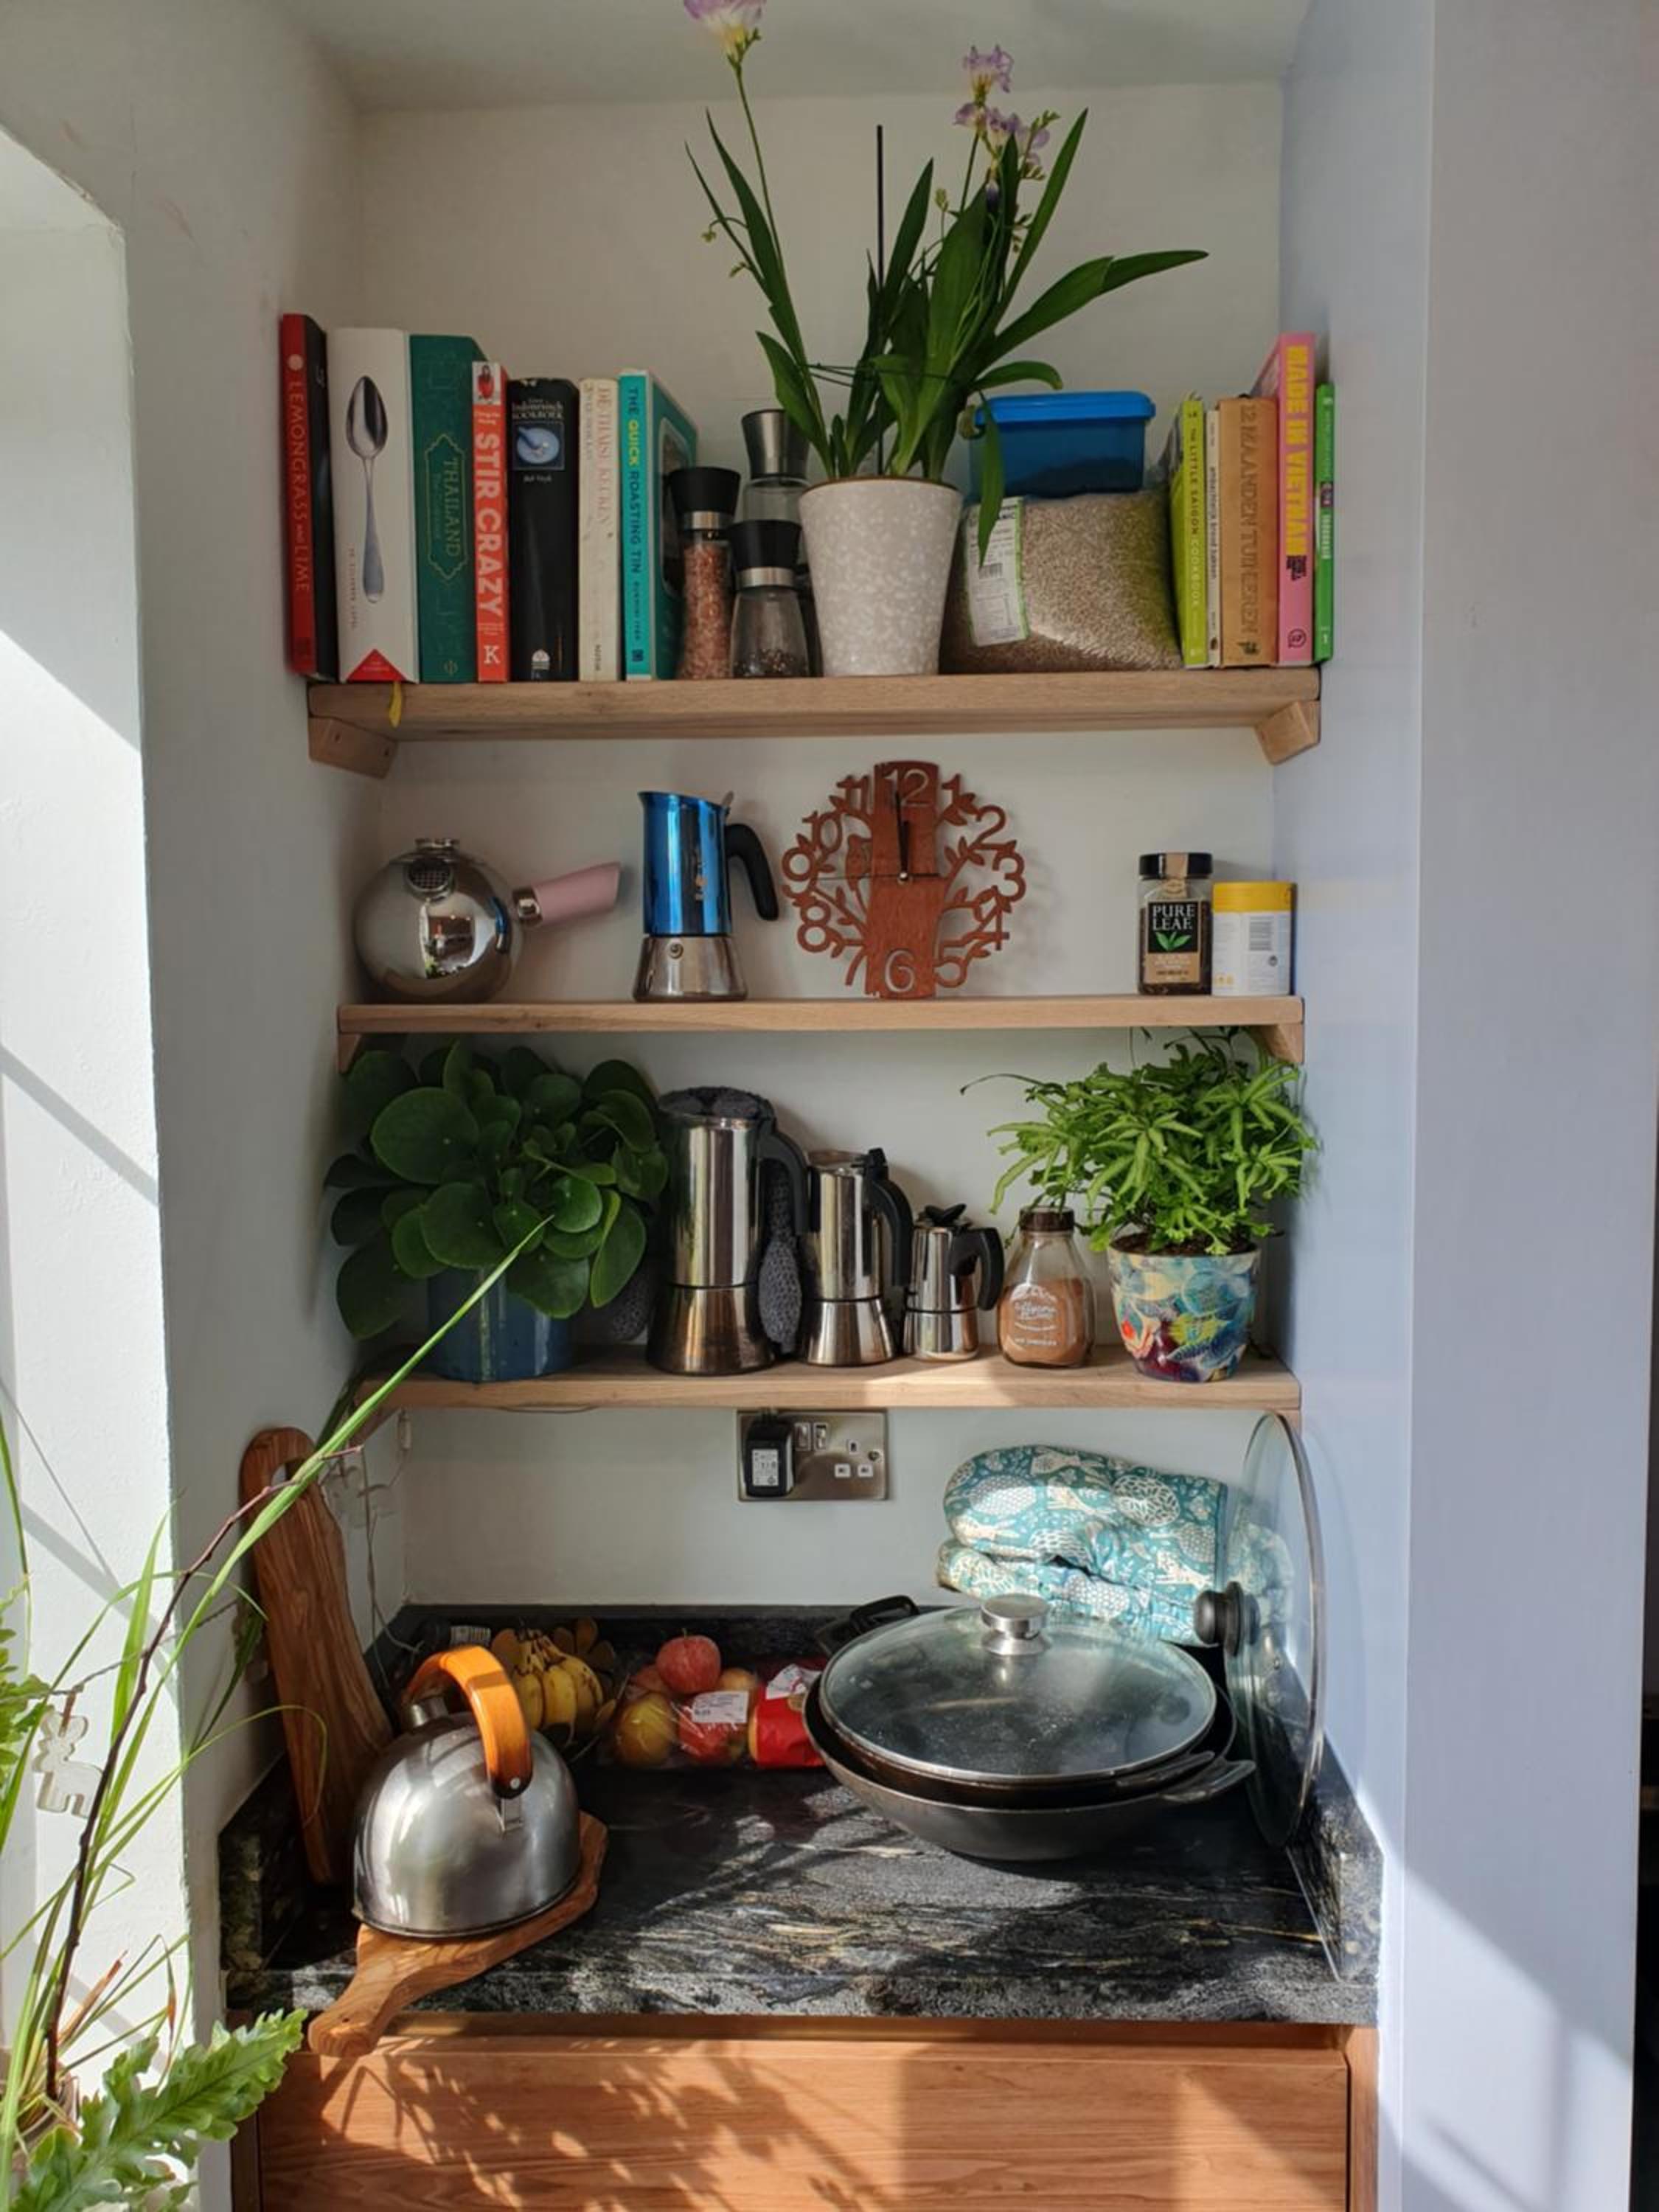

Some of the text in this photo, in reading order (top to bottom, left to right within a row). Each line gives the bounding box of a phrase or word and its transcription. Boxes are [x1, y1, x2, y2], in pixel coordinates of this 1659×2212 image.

[1285, 344, 1309, 414] MADE
[1240, 405, 1255, 423] 12
[1286, 418, 1309, 445] IN
[289, 380, 307, 521] LEMONGRASS
[476, 431, 501, 500] STIR
[1189, 446, 1200, 485] LITTLE
[627, 387, 641, 573] THE QUICK ROASTING TIN
[1240, 425, 1259, 526] MAANDEN
[442, 456, 461, 557] THAILAND
[1190, 490, 1200, 535] SAIGON
[1286, 451, 1309, 555] VIETNAM
[294, 546, 310, 592] LIME
[477, 509, 503, 616] CRAZY
[1191, 540, 1201, 608] COOKBOOK
[484, 645, 501, 664] K
[885, 768, 929, 807] 12
[975, 804, 1016, 851] 2
[993, 852, 1026, 902] 3
[797, 901, 832, 953] 8
[1152, 903, 1195, 918] PURE
[1152, 919, 1193, 931] LEAF
[883, 948, 915, 994] 6
